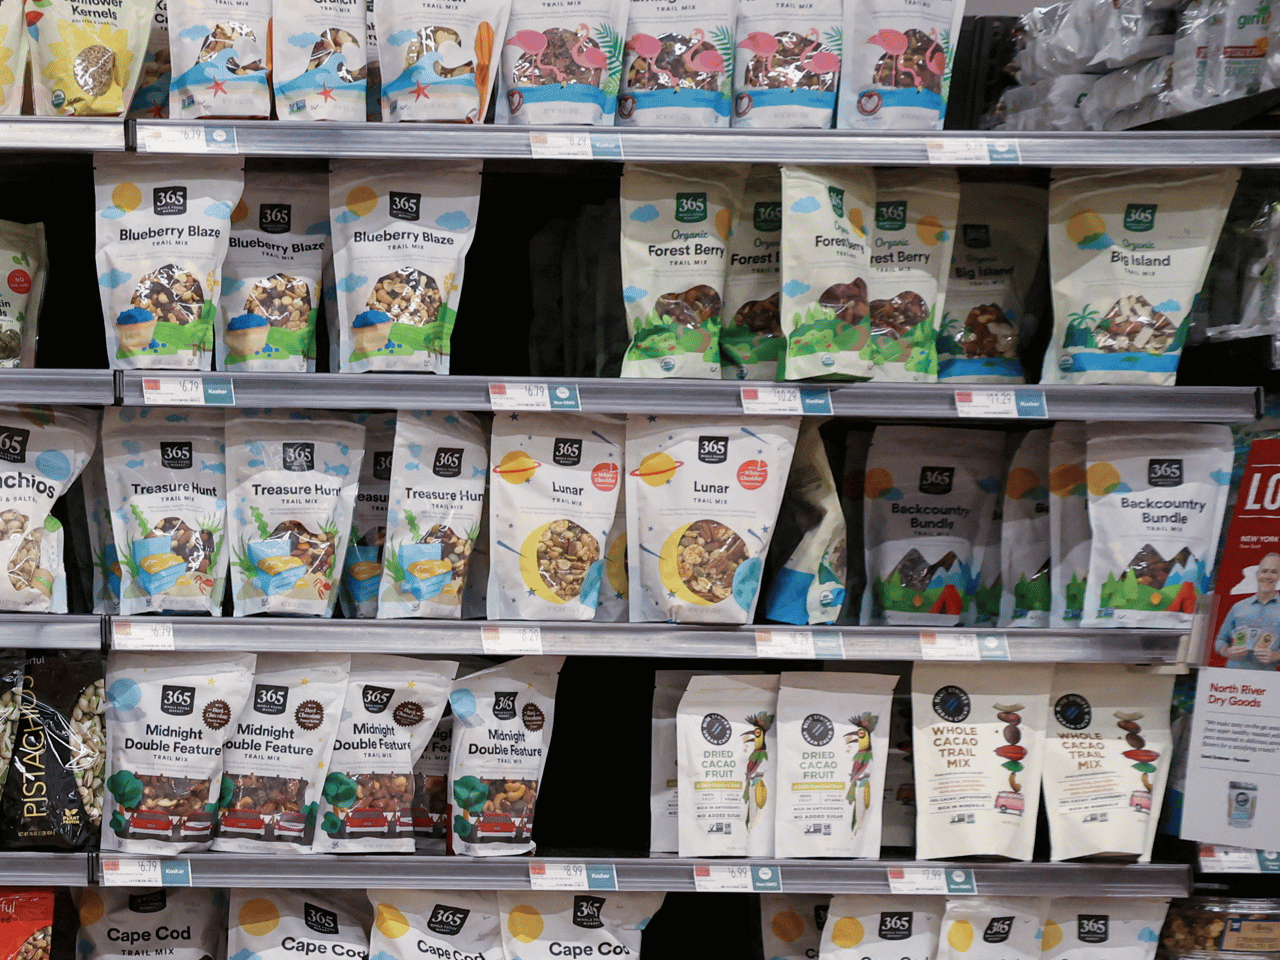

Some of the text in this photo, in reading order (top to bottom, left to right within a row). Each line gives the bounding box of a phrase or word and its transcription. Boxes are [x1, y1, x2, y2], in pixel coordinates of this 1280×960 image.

[679, 198, 704, 211] 365
[120, 226, 220, 240] Blueberry Blaze
[672, 230, 708, 240] Organic
[649, 244, 725, 258] Forest Berry
[1111, 251, 1170, 266] Big Island
[131, 482, 217, 496] Treasure Hunt
[553, 482, 584, 495] Lunar
[1122, 498, 1206, 513] Backcountry
[1143, 512, 1188, 524] Bundle
[1210, 684, 1266, 696] North River
[164, 690, 191, 705] 365
[1208, 695, 1261, 708] Dry Goods
[145, 724, 203, 741] Midnight
[932, 727, 977, 735] WHOLE
[124, 738, 222, 755] Double Feature
[934, 738, 978, 746] CACAO
[939, 748, 975, 757] TRAIL
[702, 760, 736, 768] CACAO
[948, 759, 970, 768] MIX
[706, 770, 733, 778] FRUIT
[563, 865, 582, 876] $8.99
[882, 916, 909, 929] 365
[107, 926, 190, 945] Cape Cod
